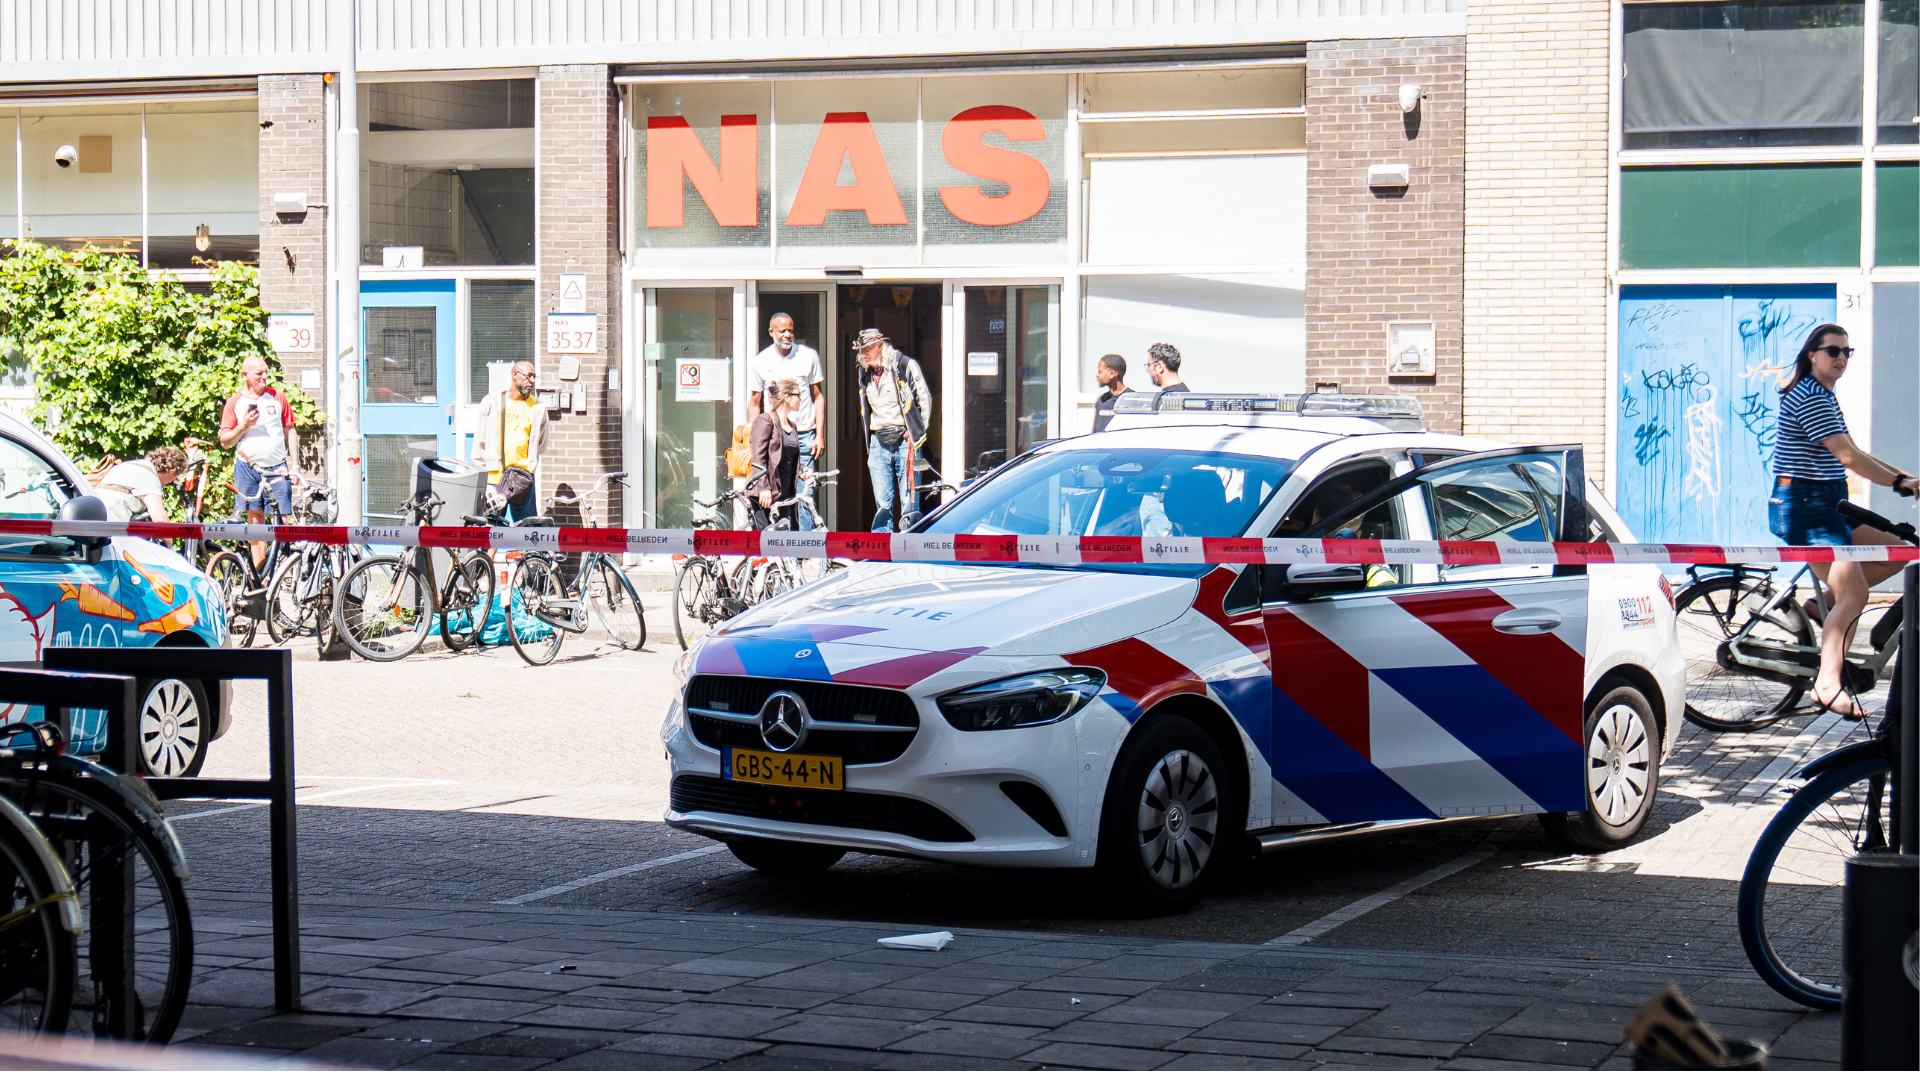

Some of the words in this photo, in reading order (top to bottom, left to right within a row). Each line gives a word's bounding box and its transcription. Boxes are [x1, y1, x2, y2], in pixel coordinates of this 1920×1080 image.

[646, 105, 1051, 228] NAS
[1845, 294, 1861, 309] 31
[289, 328, 311, 348] 39
[551, 331, 571, 349] 35
[573, 331, 593, 349] 37
[1619, 597, 1636, 609] 0900
[1621, 610, 1638, 621] 8844
[724, 766, 732, 774] NL
[736, 753, 834, 784] GBS-44-N
